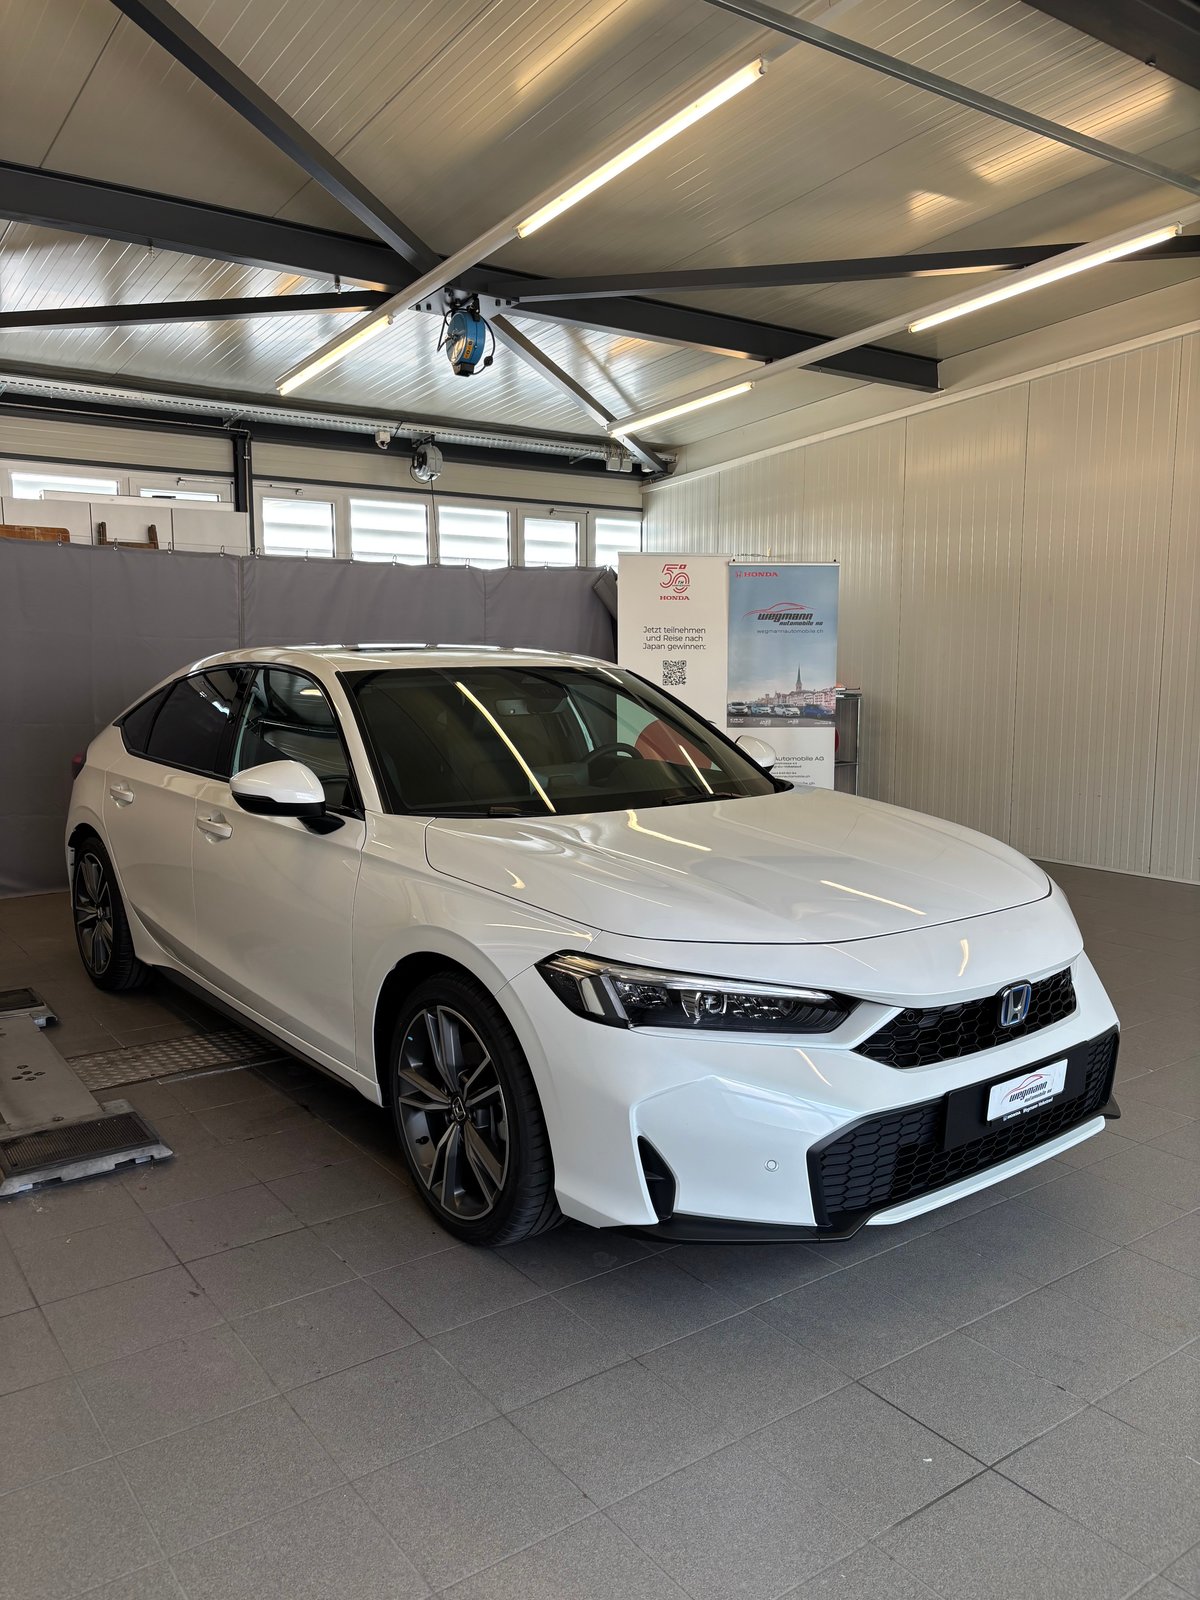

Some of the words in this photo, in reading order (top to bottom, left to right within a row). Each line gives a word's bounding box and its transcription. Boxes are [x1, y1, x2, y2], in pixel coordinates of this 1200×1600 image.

[757, 613, 813, 622] wegmann
[643, 626, 662, 634] Jetzt
[663, 626, 706, 634] teilnehmen
[643, 643, 666, 651] Japan
[667, 643, 706, 651] gewinnen:
[1009, 1081, 1047, 1102] wegmann
